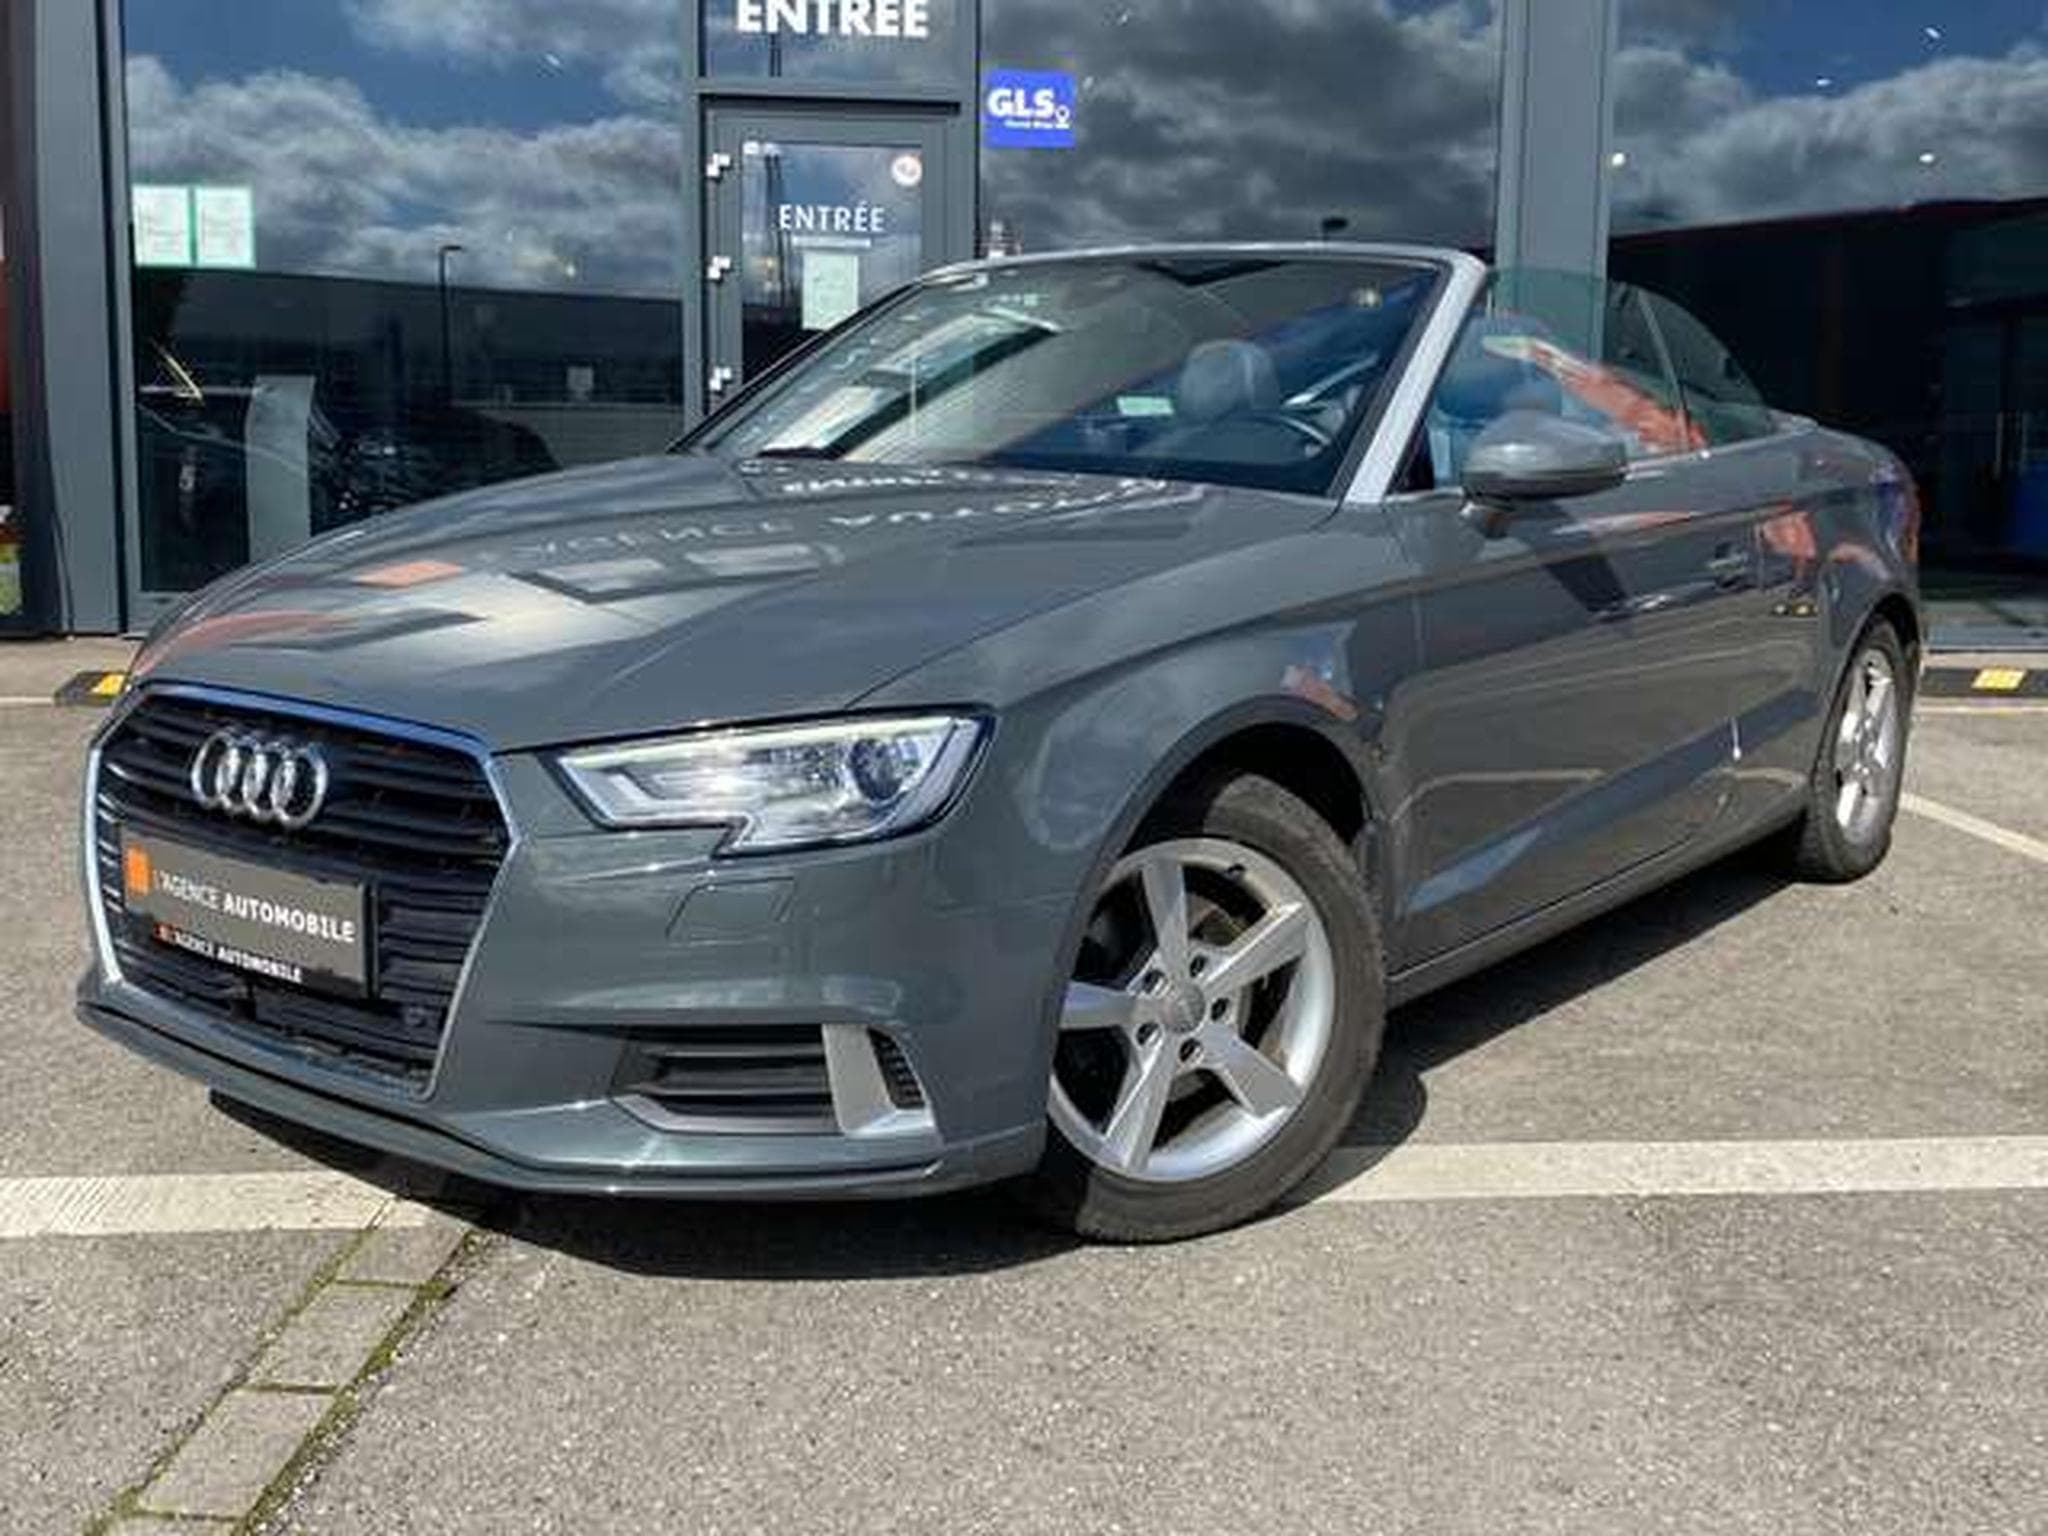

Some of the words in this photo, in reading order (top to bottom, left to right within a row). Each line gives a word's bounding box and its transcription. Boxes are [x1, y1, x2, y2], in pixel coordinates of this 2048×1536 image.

[988, 87, 1055, 118] GLS
[779, 200, 885, 232] ENTRÉE
[223, 892, 356, 943] AUTOMOBILE
